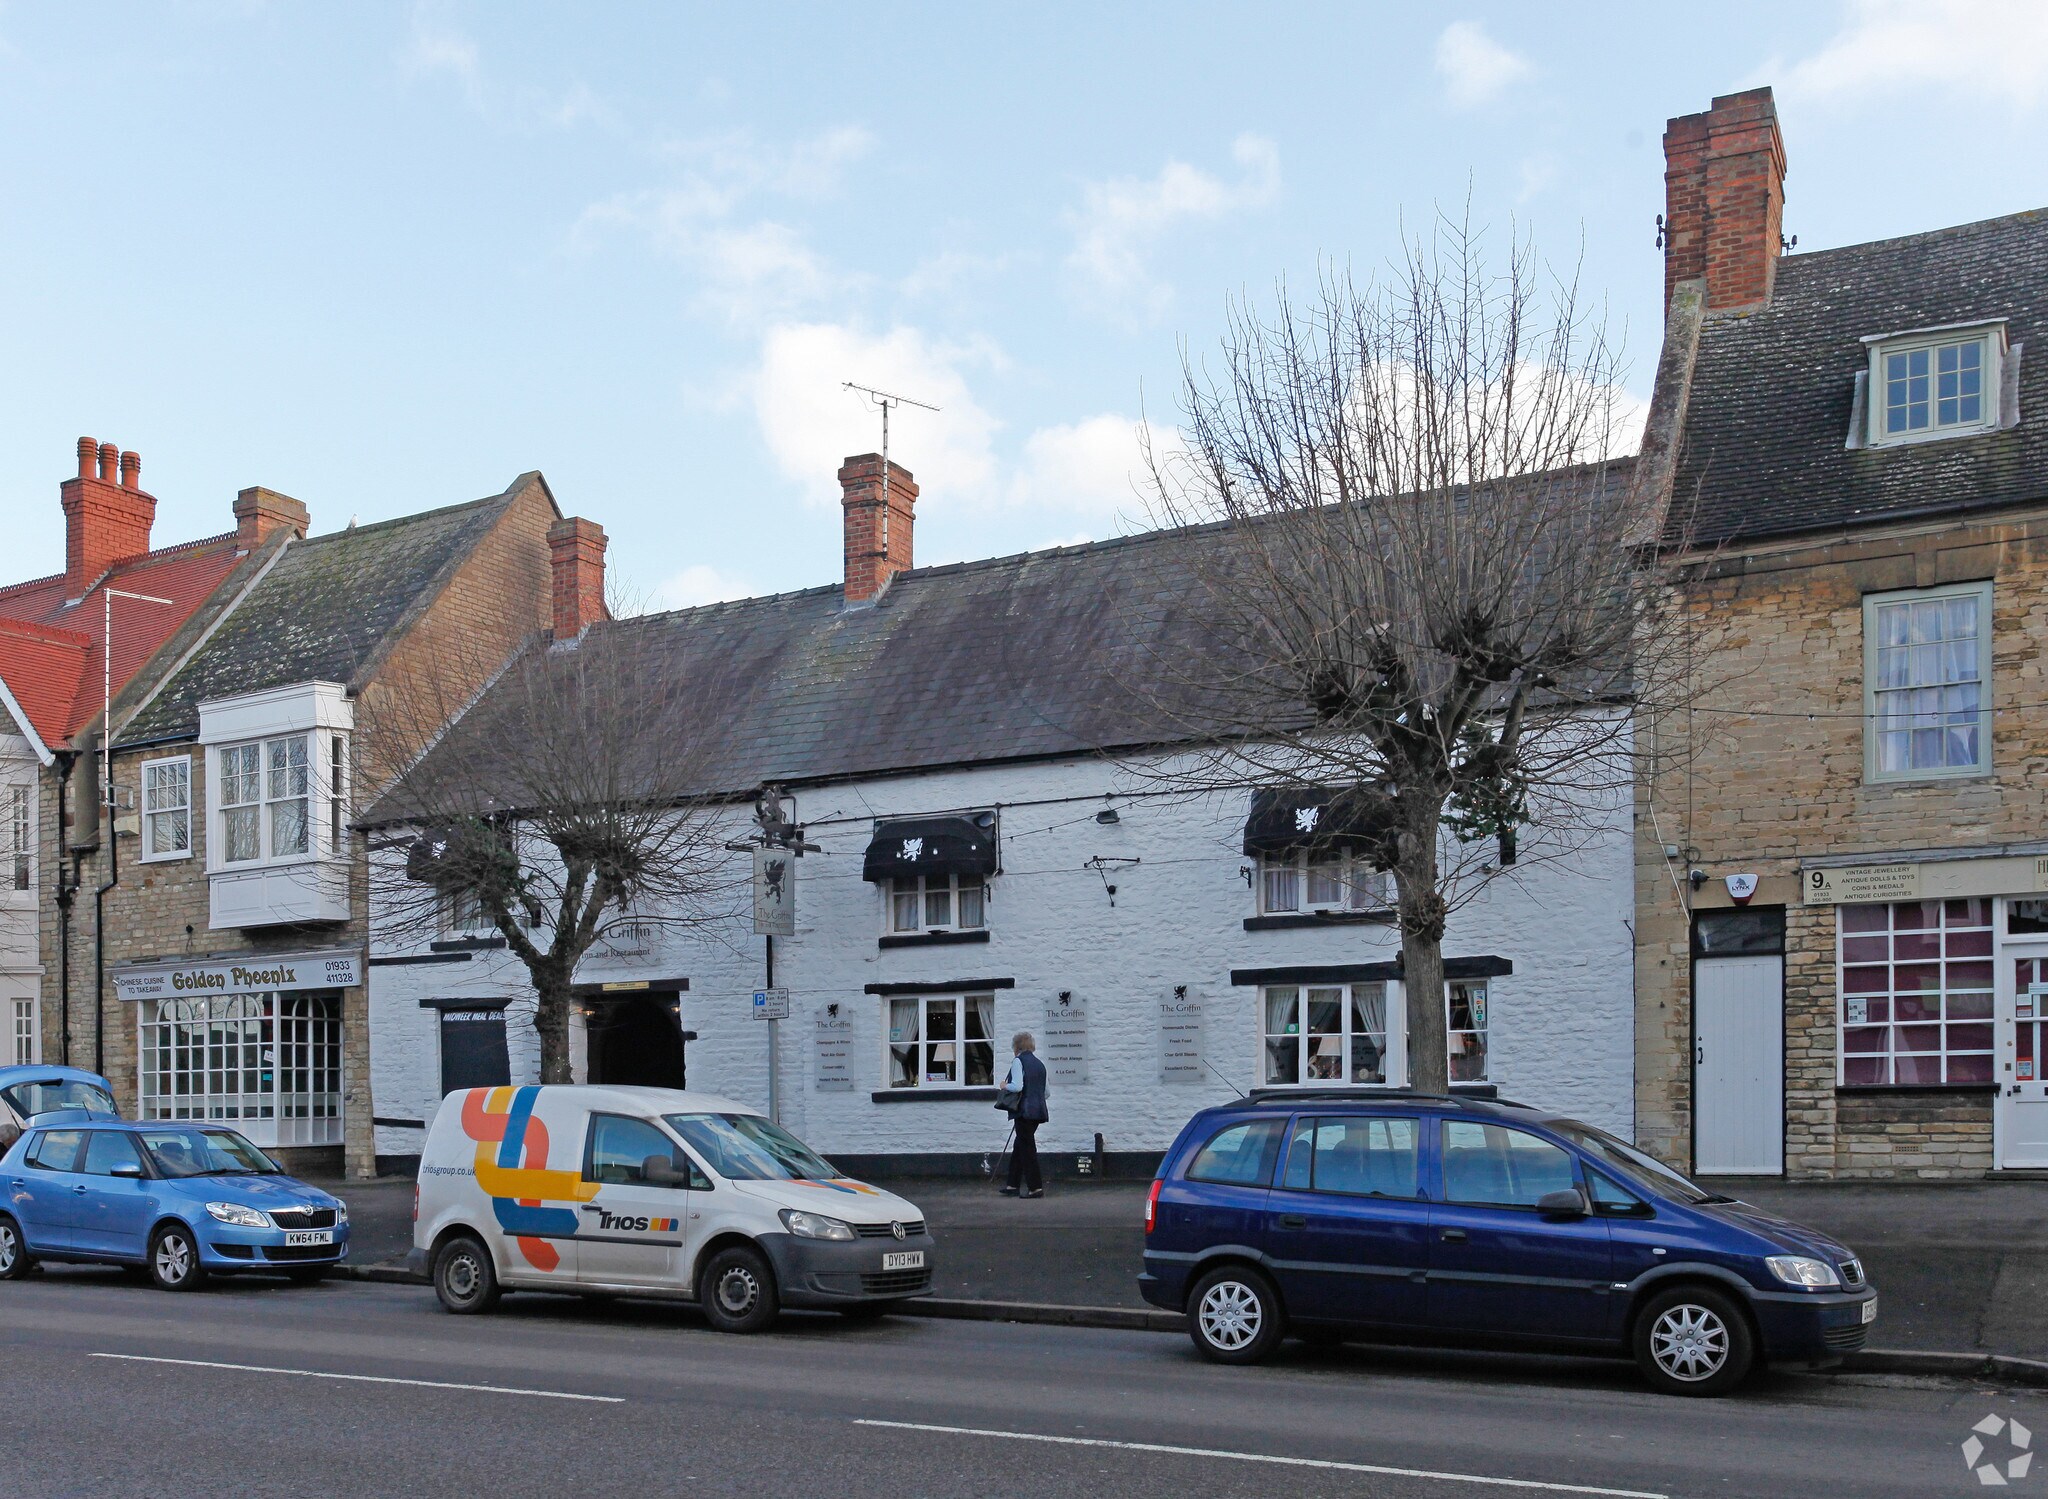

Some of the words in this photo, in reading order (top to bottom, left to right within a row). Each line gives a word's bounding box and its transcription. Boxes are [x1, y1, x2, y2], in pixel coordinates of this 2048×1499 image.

[608, 924, 651, 940] Griffin
[610, 948, 650, 958] Restaurant
[325, 960, 350, 972] 01933
[120, 978, 142, 987] CHINESE
[144, 976, 166, 985] CUISINE
[172, 970, 226, 991] Golden
[230, 964, 298, 989] Phoenix
[326, 972, 354, 984] 411328
[136, 986, 162, 994] TAKEAWAY
[1046, 1009, 1059, 1018] The
[1060, 1008, 1085, 1018] Griffin
[1160, 1004, 1174, 1012] The
[1176, 1004, 1201, 1013] Griffin
[442, 1012, 471, 1021] MIDWEEK
[472, 1012, 487, 1021] MEAL
[816, 1020, 828, 1028] The
[830, 1020, 851, 1029] Griffin
[422, 1164, 476, 1176] triosgroup.co.uk
[290, 1232, 312, 1244] KW64
[314, 1232, 329, 1242] FML
[888, 1254, 906, 1266] DY13
